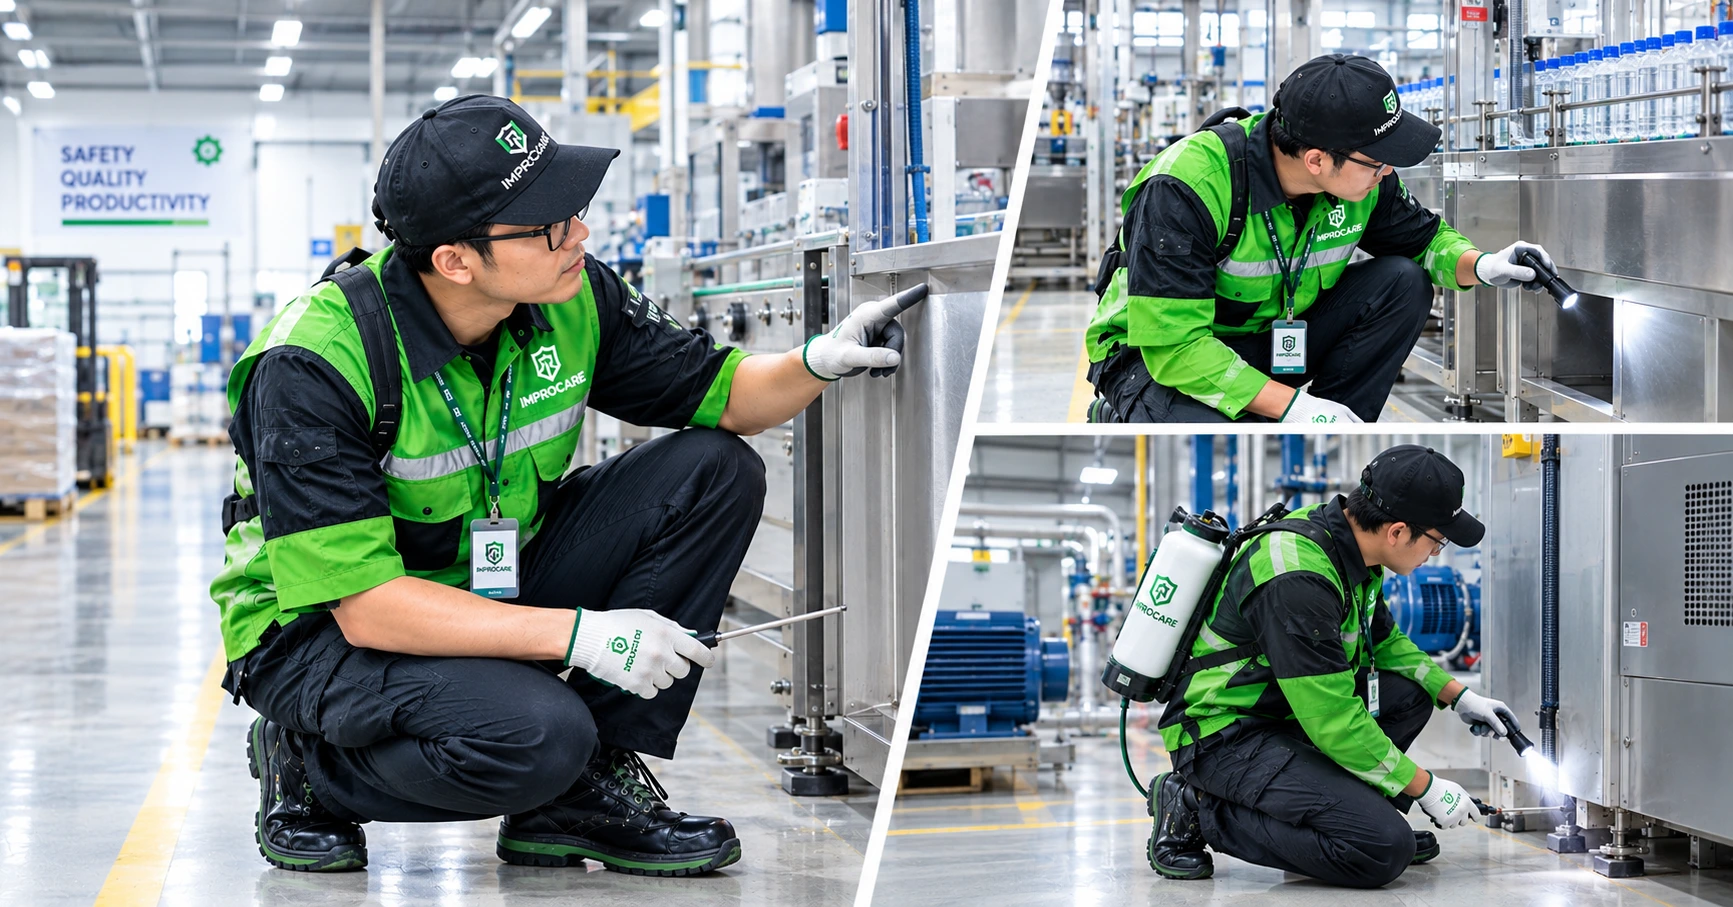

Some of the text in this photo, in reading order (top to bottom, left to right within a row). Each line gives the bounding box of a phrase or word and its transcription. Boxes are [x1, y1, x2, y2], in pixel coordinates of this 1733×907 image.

[61, 145, 134, 163] SAFETY
[61, 170, 147, 188] QUALITY
[61, 194, 210, 211] PRODUCTIVITY
[519, 370, 587, 409] IMPROCARE
